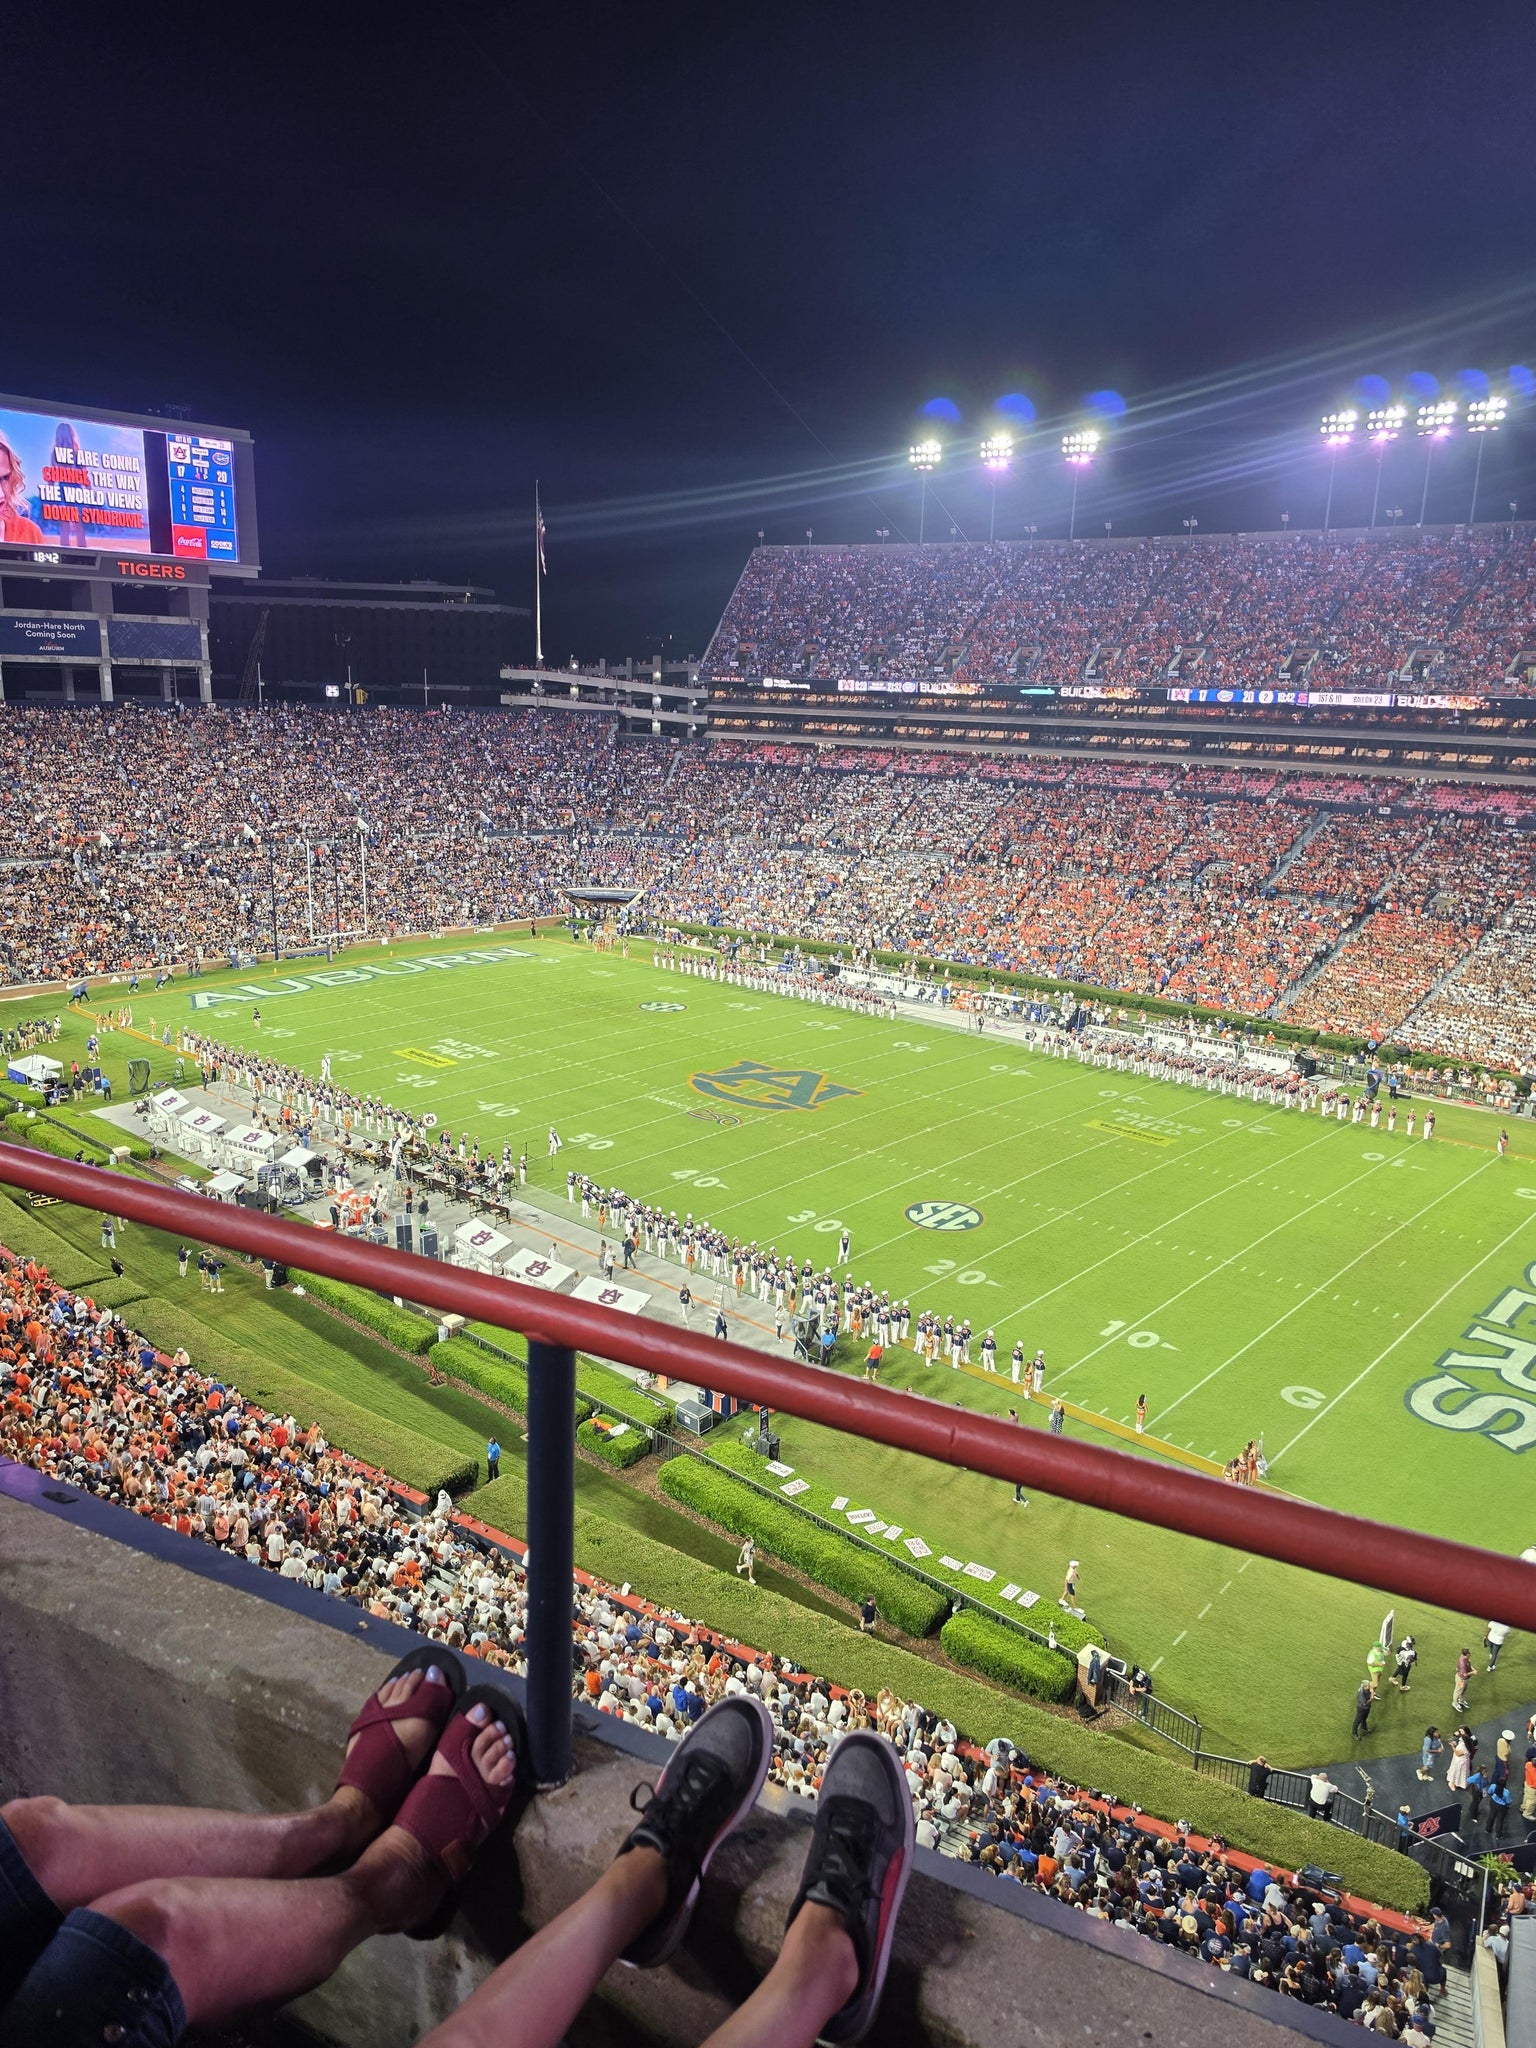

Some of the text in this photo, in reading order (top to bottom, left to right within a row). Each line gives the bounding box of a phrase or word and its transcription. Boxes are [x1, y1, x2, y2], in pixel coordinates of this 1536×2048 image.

[55, 447, 140, 473] WE ARE GONNA
[42, 466, 140, 491] CHANGE THE WAY
[177, 466, 185, 477] 17
[217, 471, 227, 483] 20
[39, 485, 142, 510] THE WORLD VIEWS
[43, 504, 144, 528] DOWN SYNDROME
[34, 552, 59, 564] 18:42
[118, 561, 186, 579] TIGERS
[14, 621, 62, 630] Jordan-Hare
[26, 630, 55, 639] Coming
[1318, 695, 1328, 703] 1ST
[1374, 696, 1383, 704] 23
[189, 946, 538, 1010] AUBURN
[429, 1045, 474, 1059] FIELD
[464, 1045, 500, 1058] DYE
[396, 1074, 438, 1088] 30
[688, 1060, 866, 1110] AU
[478, 1102, 520, 1117] 40
[1112, 1108, 1206, 1134] PAT DYE
[1115, 1116, 1182, 1135] FIELD
[568, 1133, 614, 1150] 50
[670, 1169, 720, 1188] 40
[787, 1210, 842, 1232] 30
[908, 1202, 980, 1230] SEC
[470, 1230, 494, 1246] AU
[525, 1259, 552, 1277] AU
[923, 1259, 986, 1285] 20
[598, 1288, 624, 1305] AU
[1099, 1320, 1161, 1349] 10
[1280, 1386, 1327, 1410] G
[1418, 1817, 1440, 1837] AU
